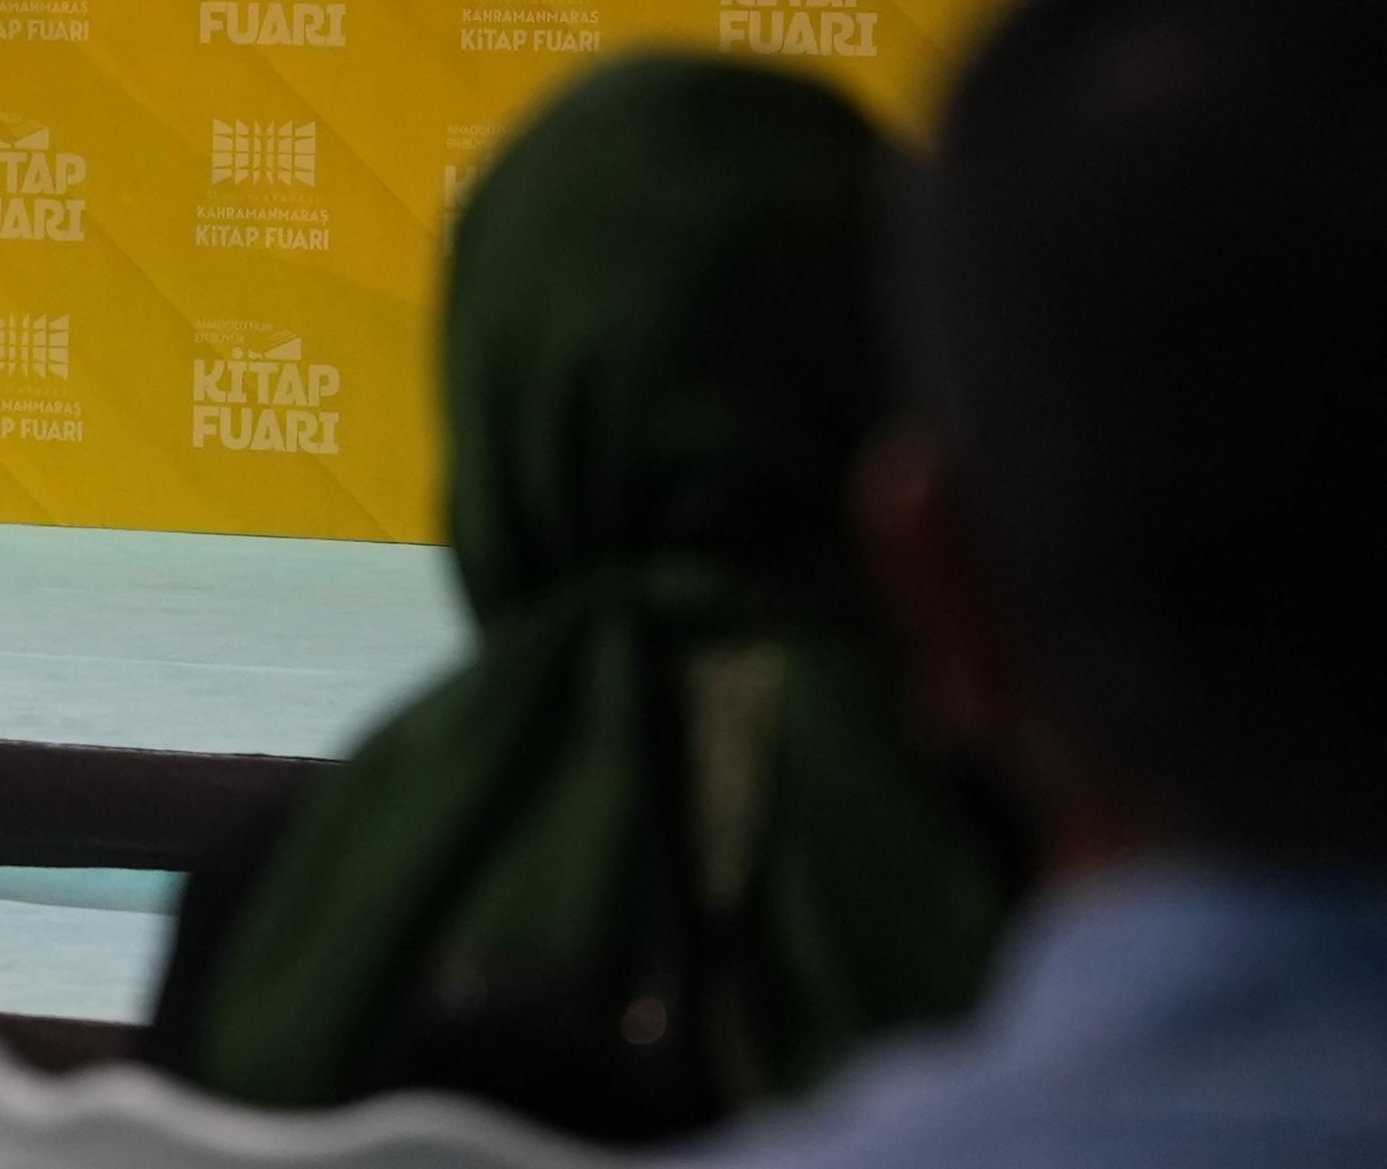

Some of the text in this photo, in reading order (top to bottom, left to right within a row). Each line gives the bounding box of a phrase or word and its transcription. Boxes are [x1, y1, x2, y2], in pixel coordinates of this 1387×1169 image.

[27, 19, 90, 42] FUARI
[199, 2, 347, 46] FUARI
[719, 10, 879, 56] FUARI
[533, 29, 601, 52] FUARI
[265, 227, 331, 252] FUARI
[21, 418, 84, 444] FUARI
[192, 404, 340, 454] FUARI
